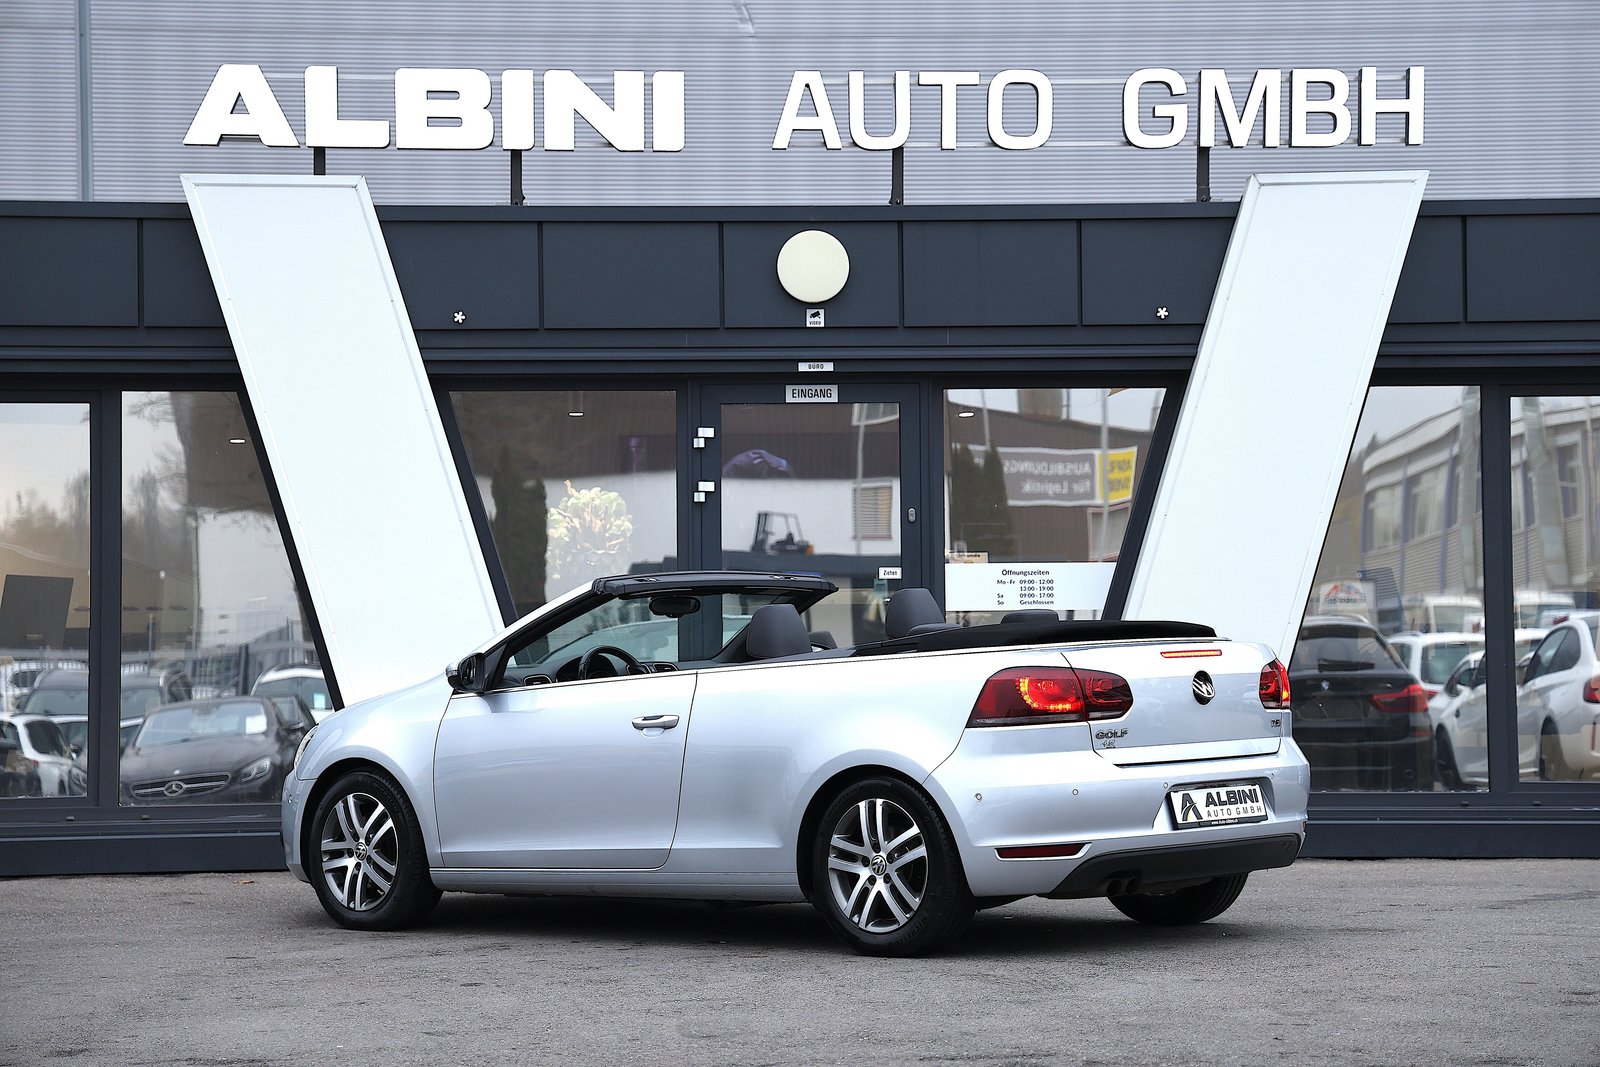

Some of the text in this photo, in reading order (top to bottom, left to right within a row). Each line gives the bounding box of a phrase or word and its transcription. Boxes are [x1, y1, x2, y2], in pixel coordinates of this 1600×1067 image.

[183, 64, 1425, 153] ALBINI AUTO GMBH
[808, 362, 824, 370] BÜRO
[791, 388, 832, 398] EINGANG
[1001, 568, 1050, 577] Öffnungszeiten
[1095, 728, 1128, 740] GOLF
[1205, 788, 1259, 808] ALBINI
[1207, 805, 1263, 818] AUTO GMBH
